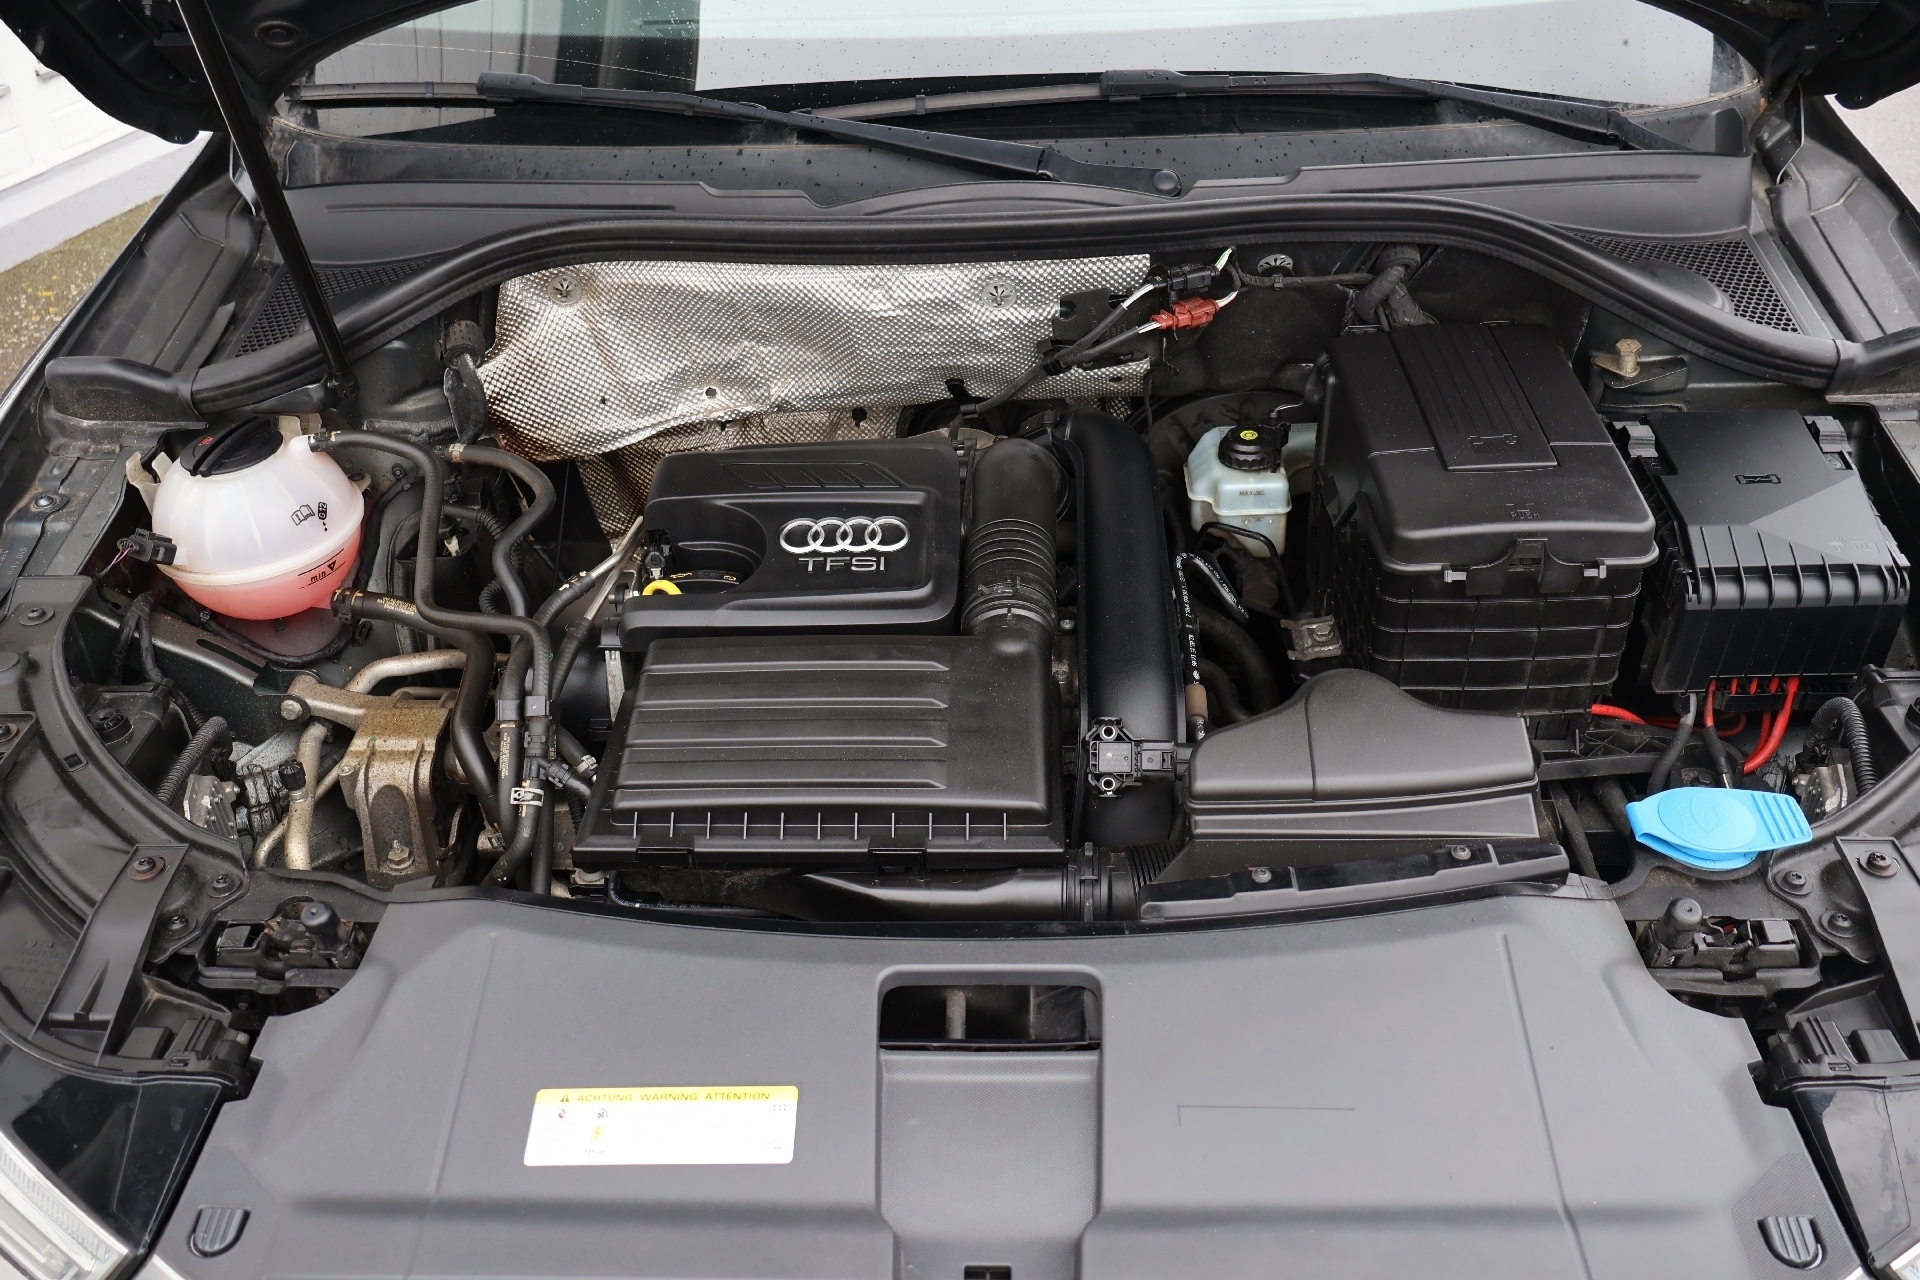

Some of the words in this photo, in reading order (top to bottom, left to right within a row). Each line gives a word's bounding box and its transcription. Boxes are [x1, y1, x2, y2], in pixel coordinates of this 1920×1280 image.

[318, 502, 327, 519] G12
[1510, 511, 1540, 519] PUSH
[798, 556, 885, 573] TFSI
[310, 571, 326, 583] min
[576, 1093, 633, 1102] ACHTUNG
[640, 1092, 698, 1101] WARNING
[704, 1092, 770, 1100] ATTENTION
